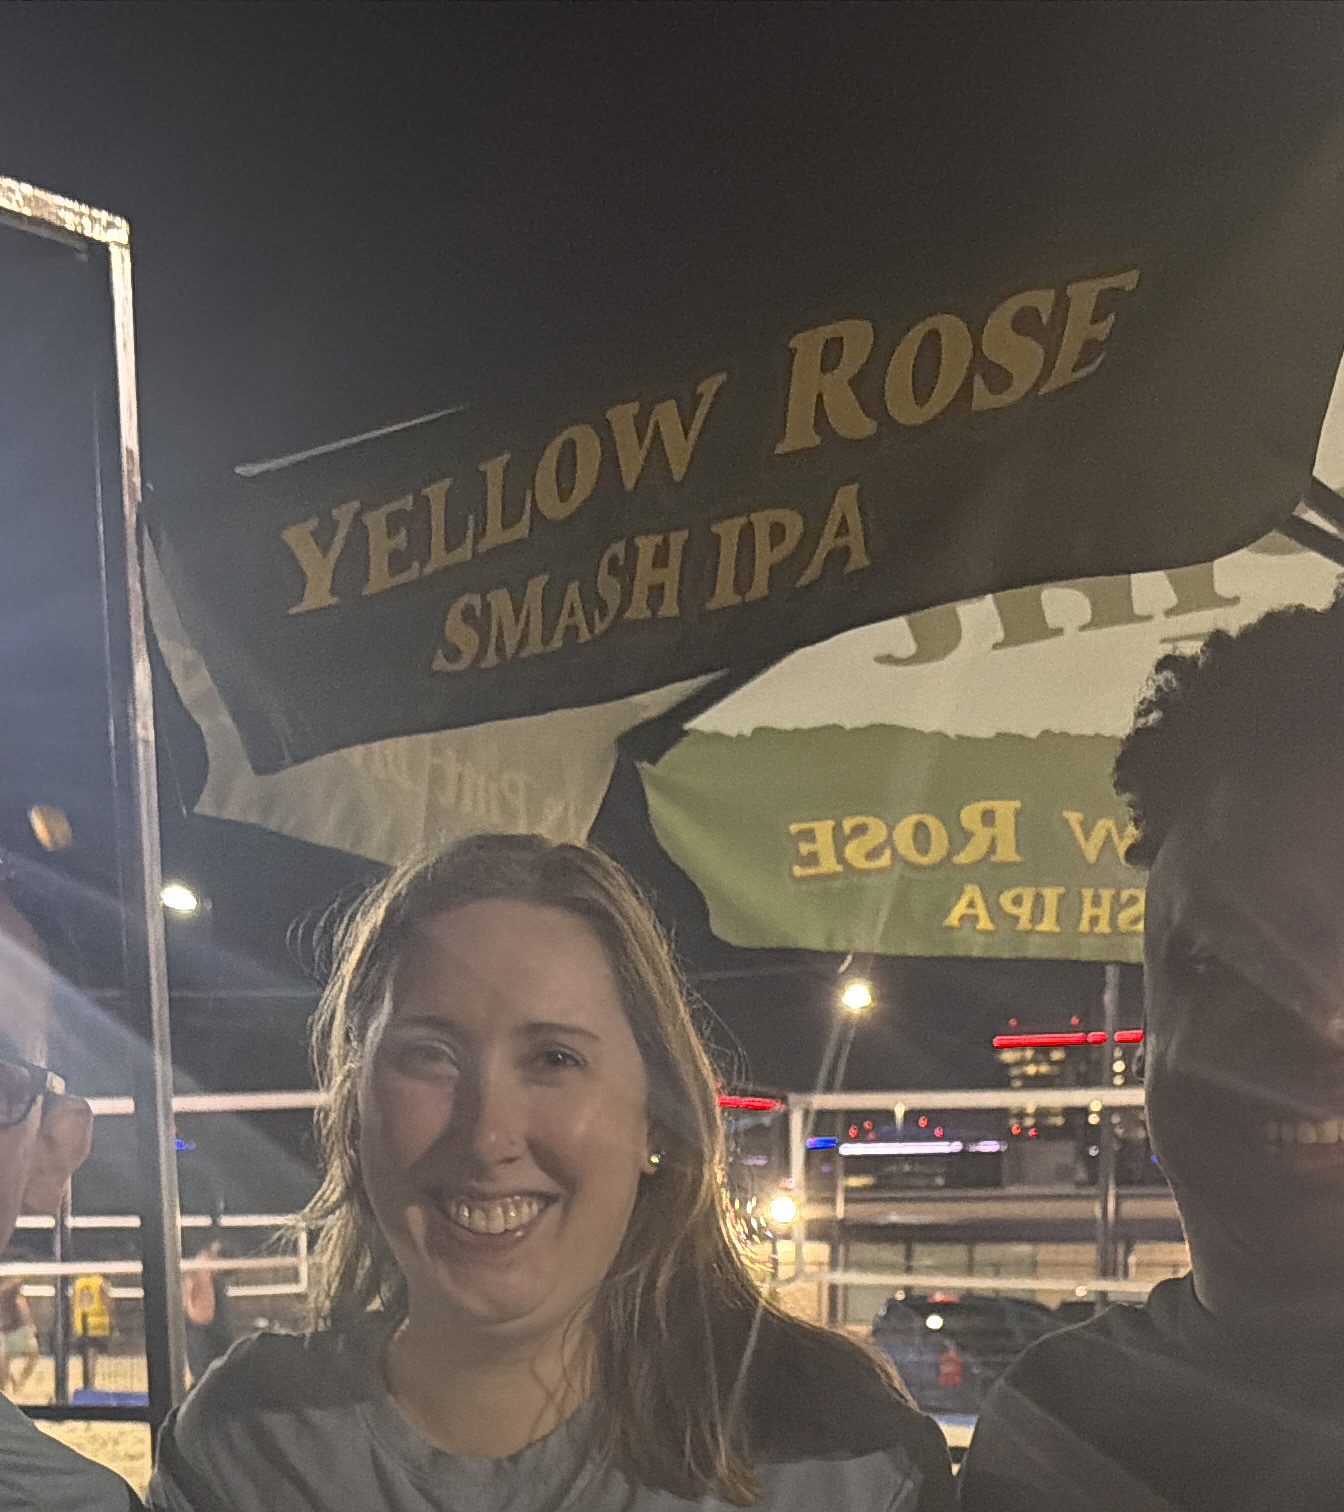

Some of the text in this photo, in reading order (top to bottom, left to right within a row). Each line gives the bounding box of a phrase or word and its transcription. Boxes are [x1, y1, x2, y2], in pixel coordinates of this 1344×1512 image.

[280, 267, 1141, 615] YELLOW ROSE
[431, 484, 872, 673] SMASH IPA
